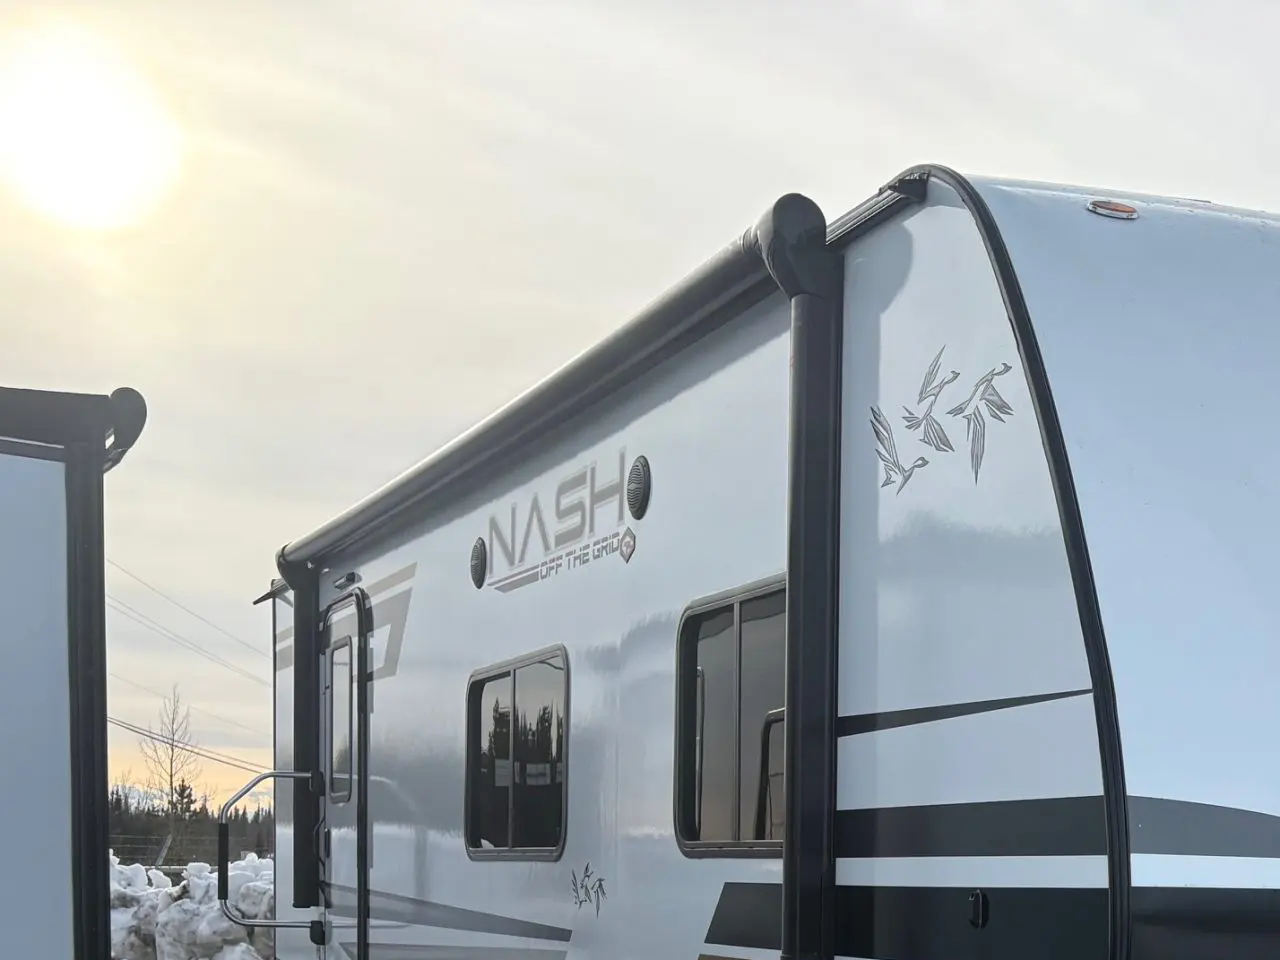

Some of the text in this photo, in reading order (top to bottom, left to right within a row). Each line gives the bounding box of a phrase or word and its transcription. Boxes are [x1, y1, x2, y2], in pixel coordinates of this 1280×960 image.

[487, 446, 627, 579] NASH
[540, 531, 620, 580] OFF THE GRID
